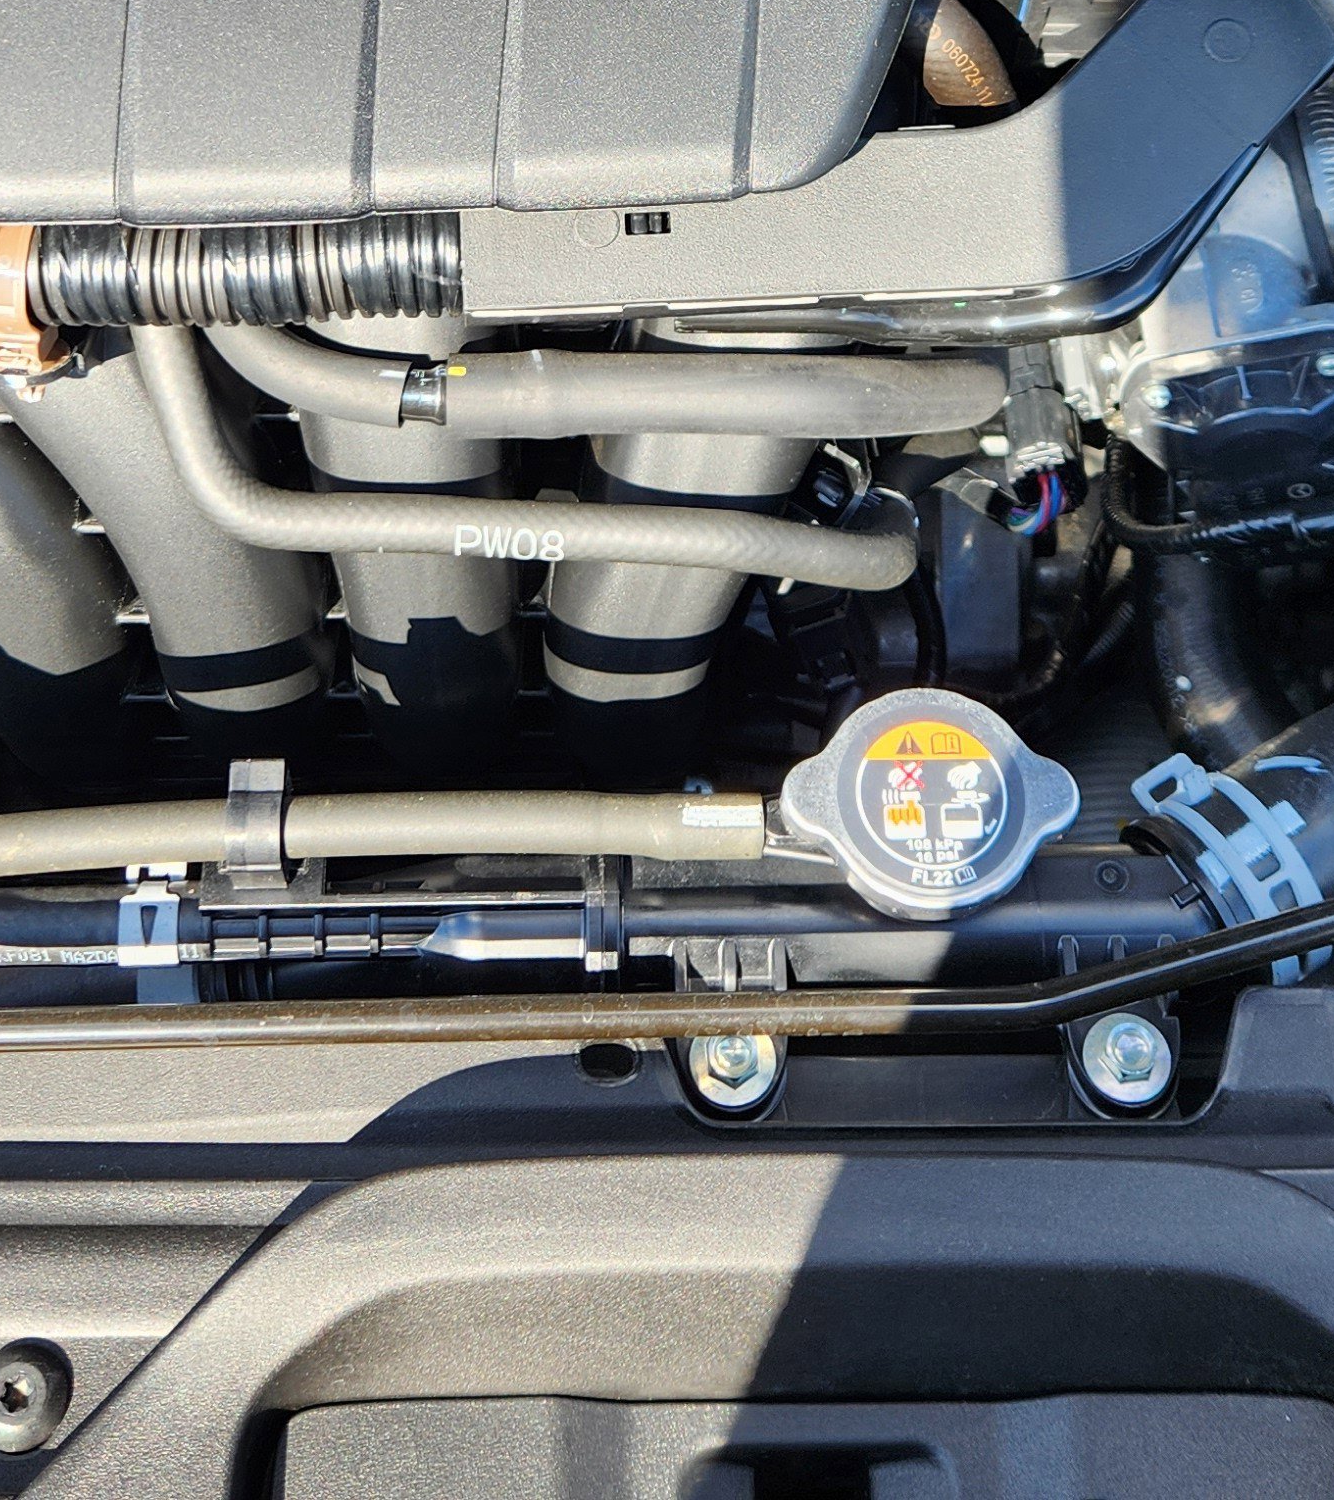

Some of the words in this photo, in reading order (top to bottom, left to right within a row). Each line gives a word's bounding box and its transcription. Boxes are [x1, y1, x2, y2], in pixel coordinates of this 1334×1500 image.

[941, 38, 985, 89] 060724
[454, 524, 565, 562] PW08
[935, 838, 965, 851] kPa
[911, 867, 954, 886] FL22
[61, 949, 118, 964] MAZDA
